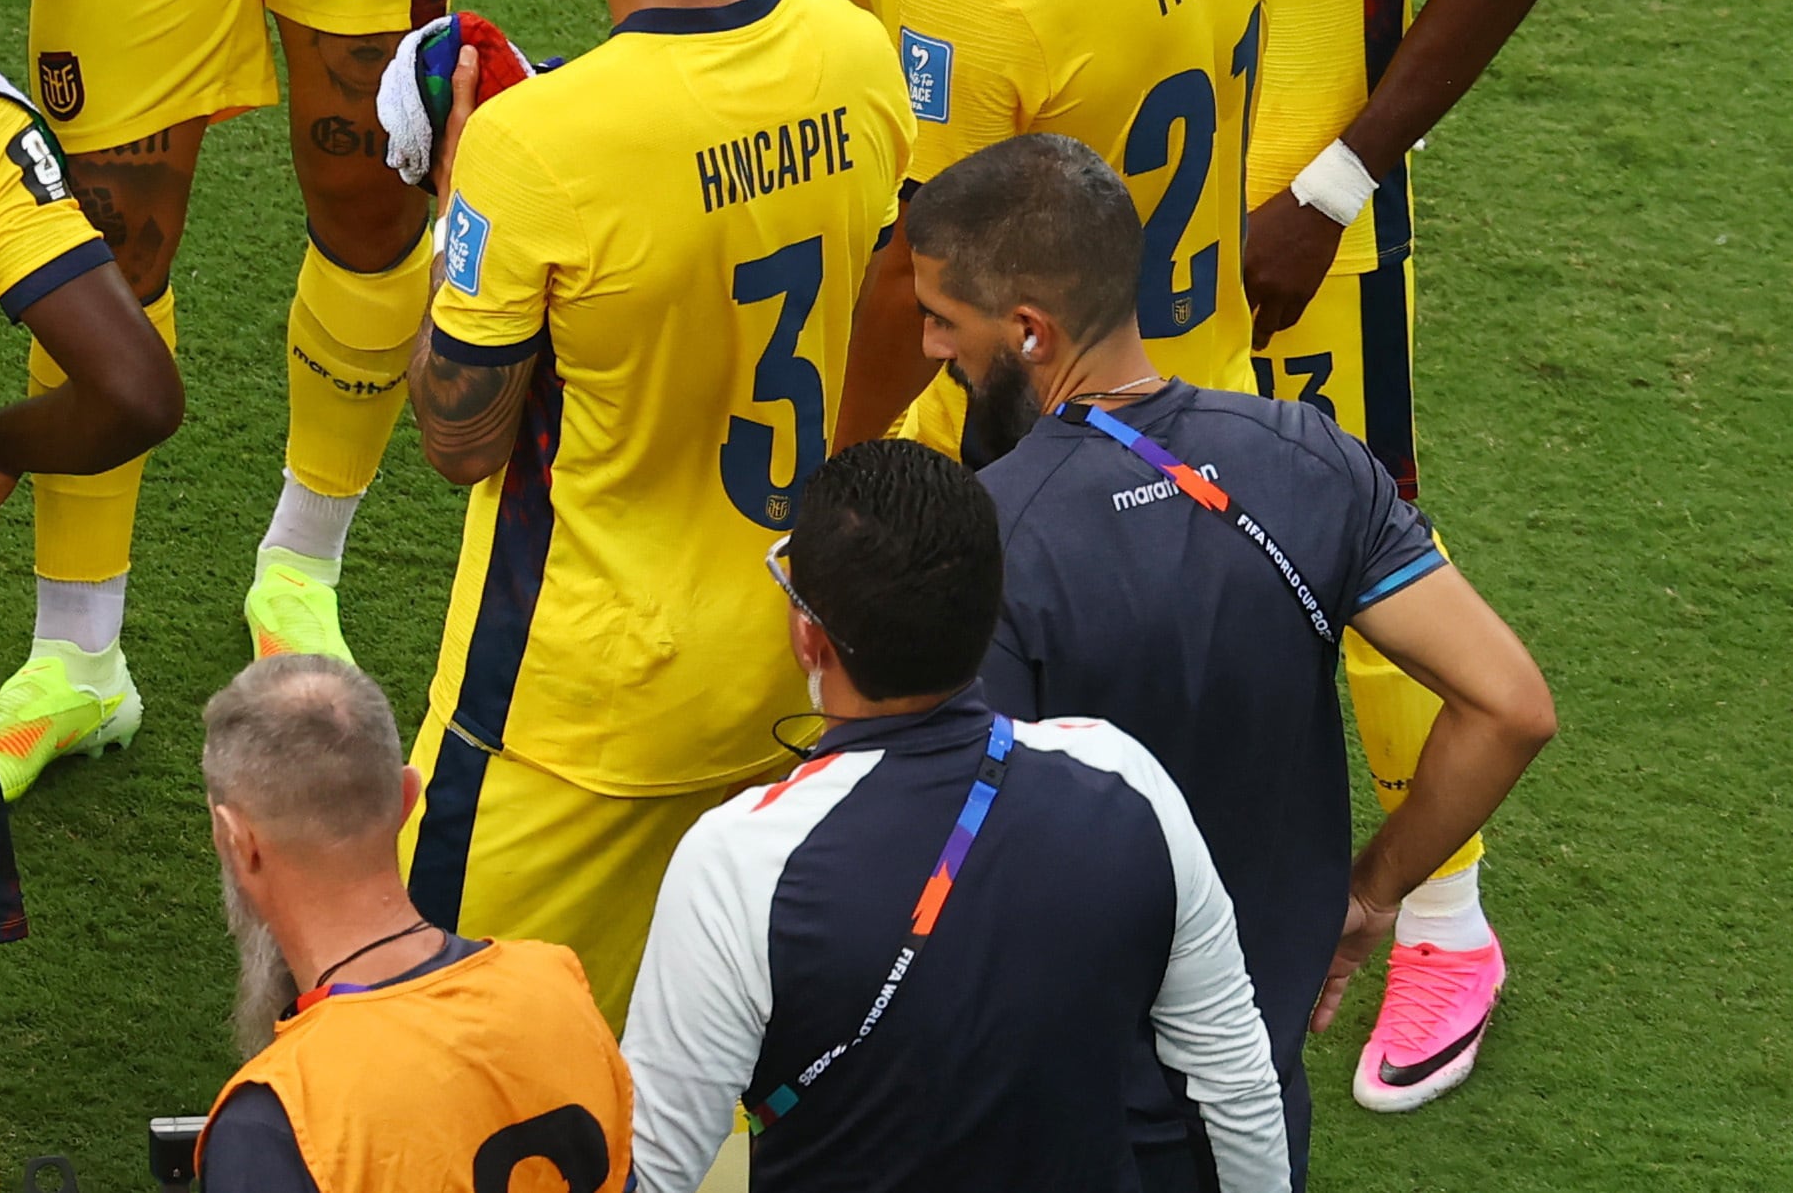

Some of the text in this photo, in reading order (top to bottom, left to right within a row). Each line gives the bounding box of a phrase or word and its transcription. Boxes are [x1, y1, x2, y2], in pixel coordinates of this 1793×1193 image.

[696, 107, 854, 214] HINCAPIE
[1123, 0, 1262, 340] 21
[293, 345, 407, 395] marathon
[720, 235, 828, 532] 3
[1112, 463, 1219, 511] maratn
[1237, 514, 1265, 545] FIFA
[1265, 538, 1301, 587] WORLD
[1297, 585, 1317, 610] CUP
[887, 946, 915, 982] FIFA
[859, 983, 897, 1037] WORLD
